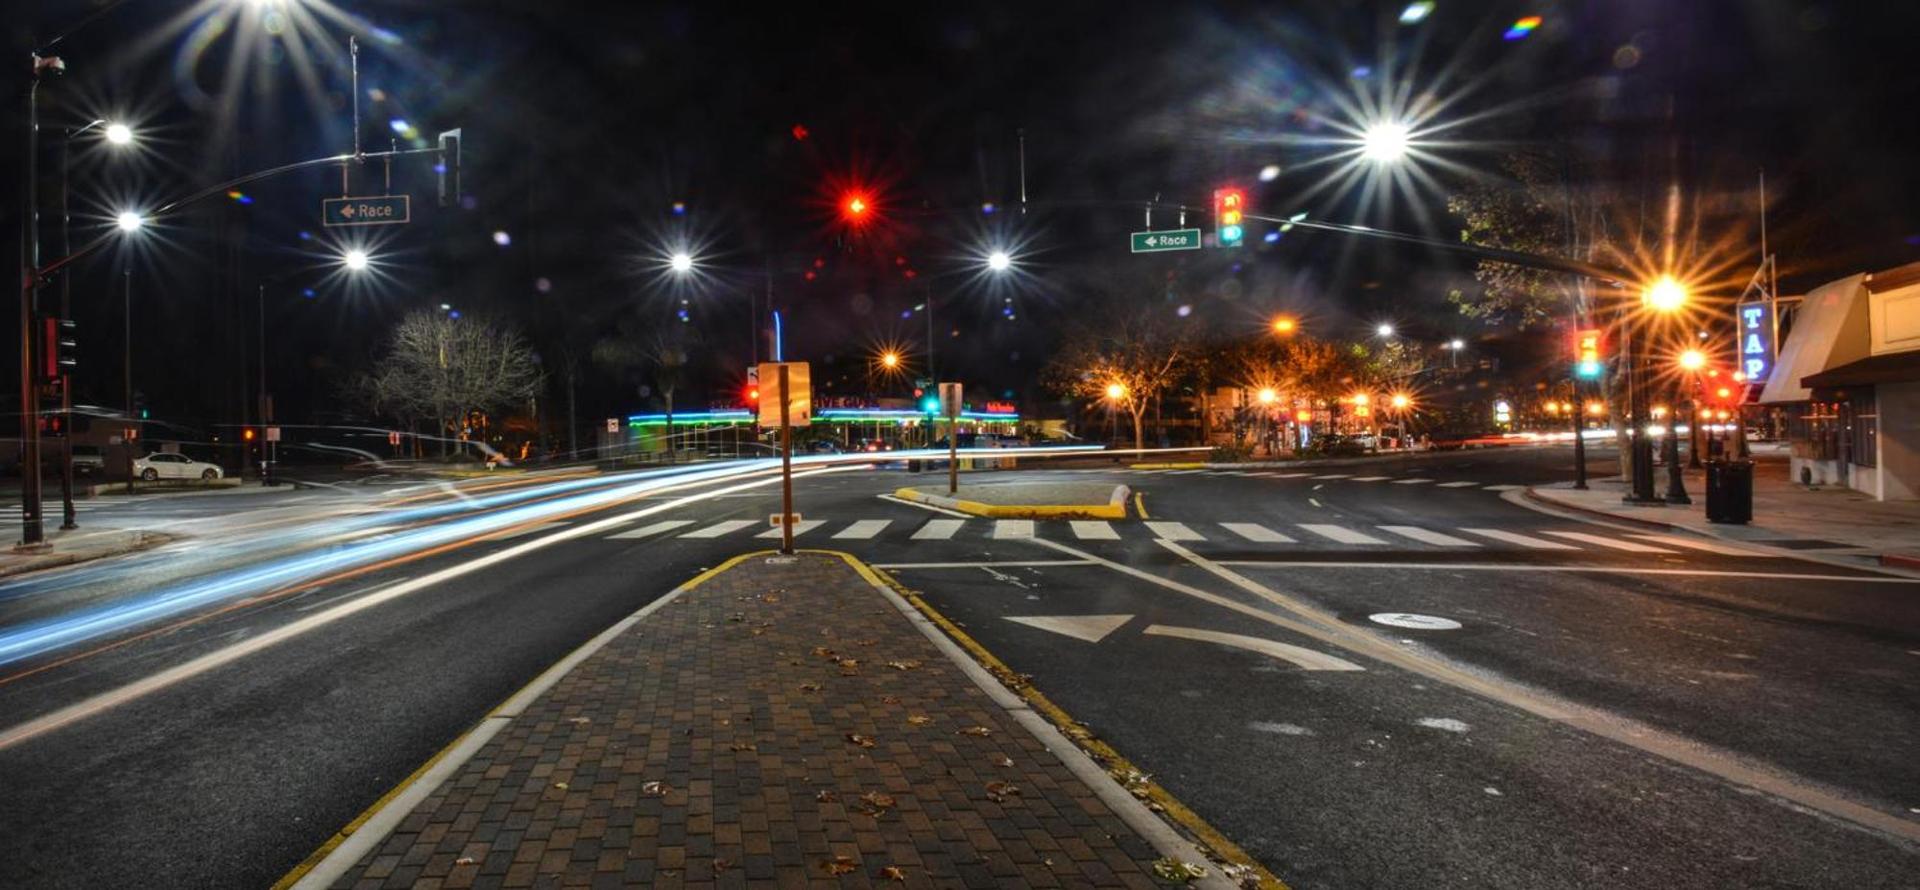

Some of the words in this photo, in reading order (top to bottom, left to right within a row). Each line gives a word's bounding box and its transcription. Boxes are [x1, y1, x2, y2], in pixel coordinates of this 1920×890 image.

[358, 204, 392, 217] Race
[1160, 235, 1188, 246] Race
[1743, 307, 1764, 380] TAP
